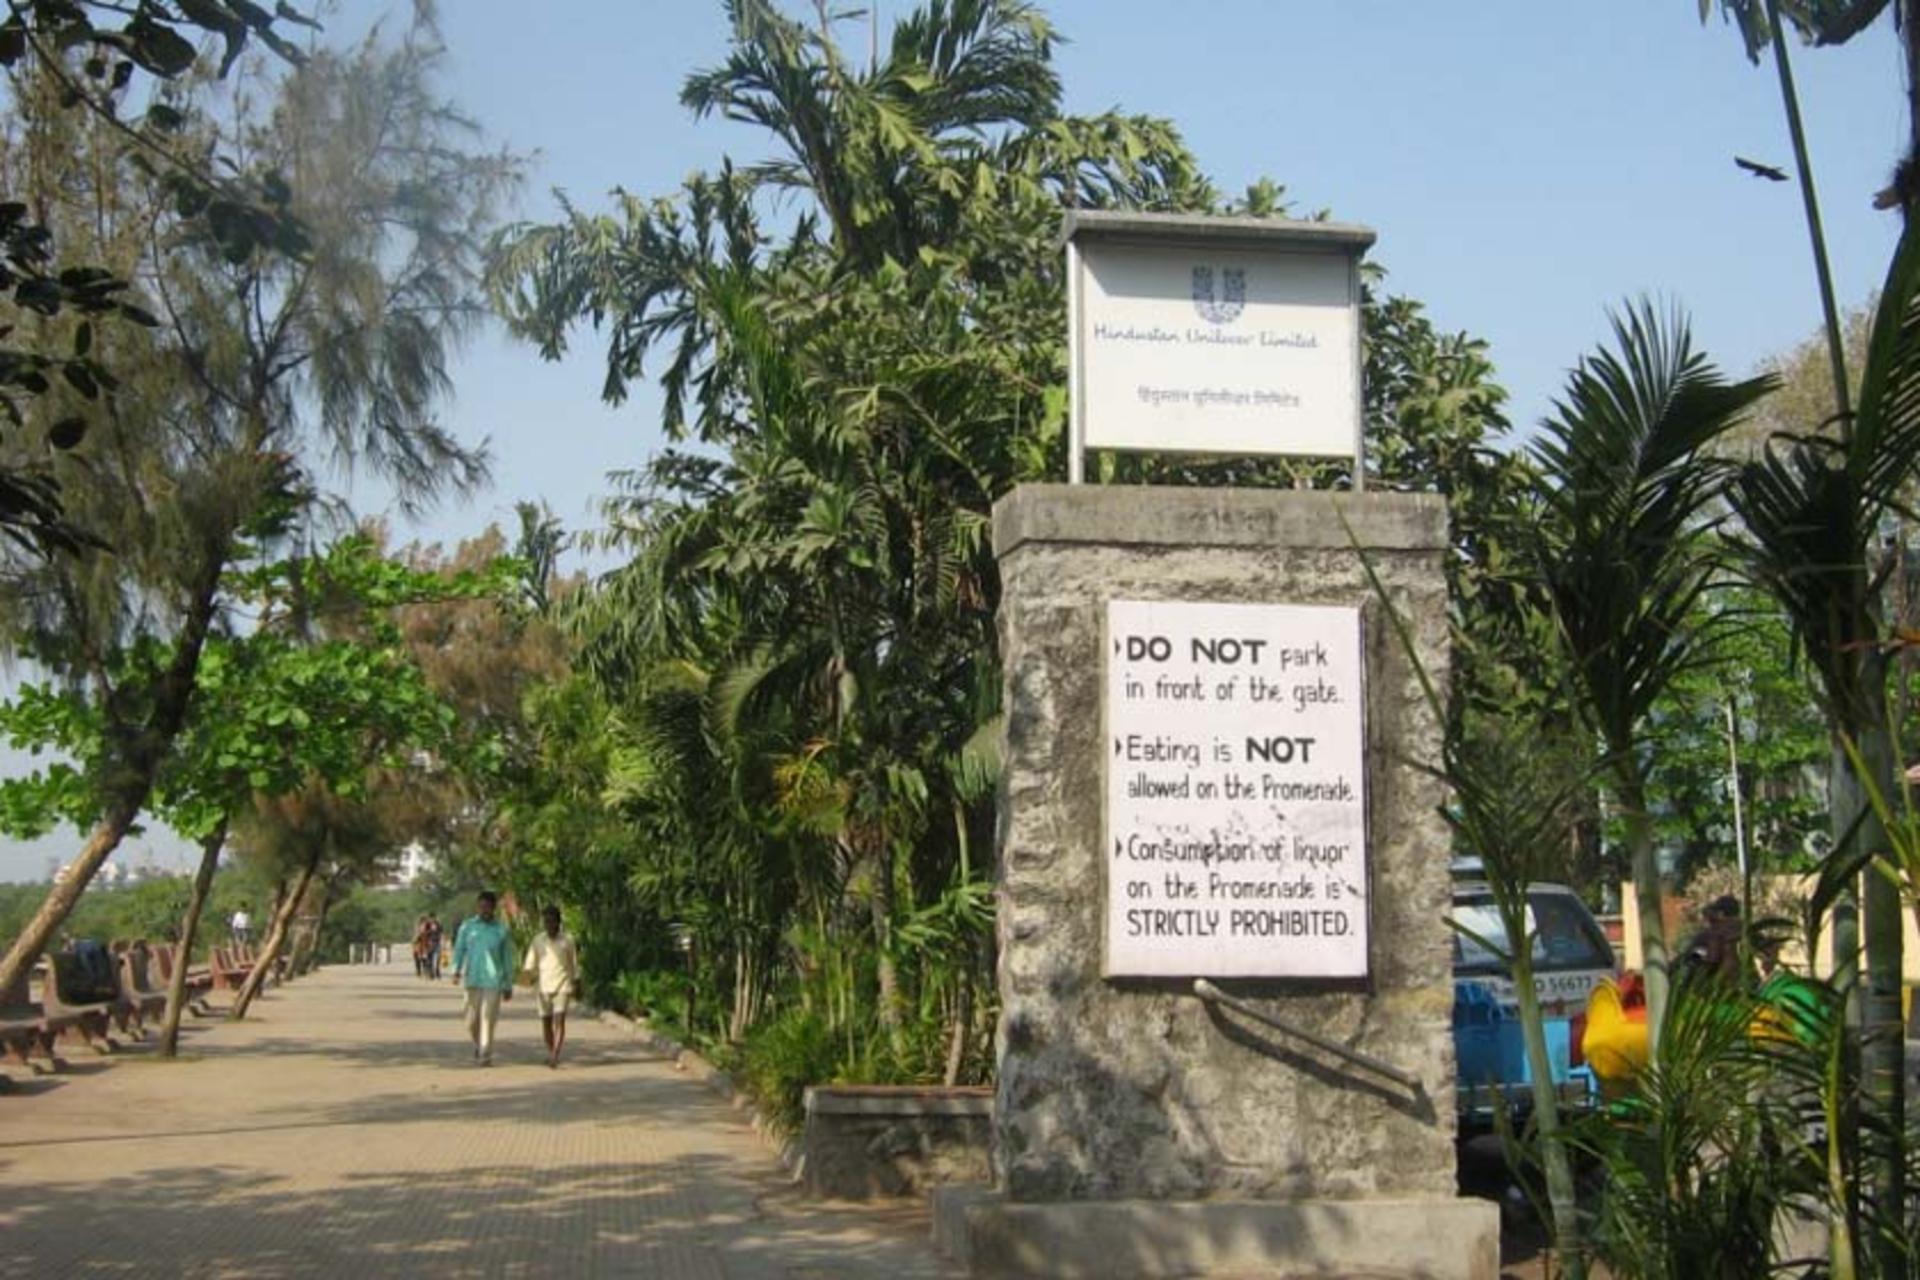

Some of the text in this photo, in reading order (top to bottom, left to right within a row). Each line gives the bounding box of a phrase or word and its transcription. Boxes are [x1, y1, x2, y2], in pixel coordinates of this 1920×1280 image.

[1094, 324, 1319, 348] Hindustan Unilever Limited
[1126, 636, 1328, 671] DO NOT park
[1125, 673, 1144, 699] in
[1156, 673, 1205, 701] front
[1216, 675, 1239, 701] of
[1250, 676, 1283, 702] the
[1127, 735, 1315, 769] Eating is NOT
[1127, 772, 1189, 800] allowed
[1196, 780, 1218, 800] on
[1224, 773, 1256, 800] the
[1127, 833, 1349, 869] Consumption of liquor
[1127, 872, 1340, 900] on the Promenade is
[1127, 909, 1354, 937] STRICTLY PROHIBITED.
